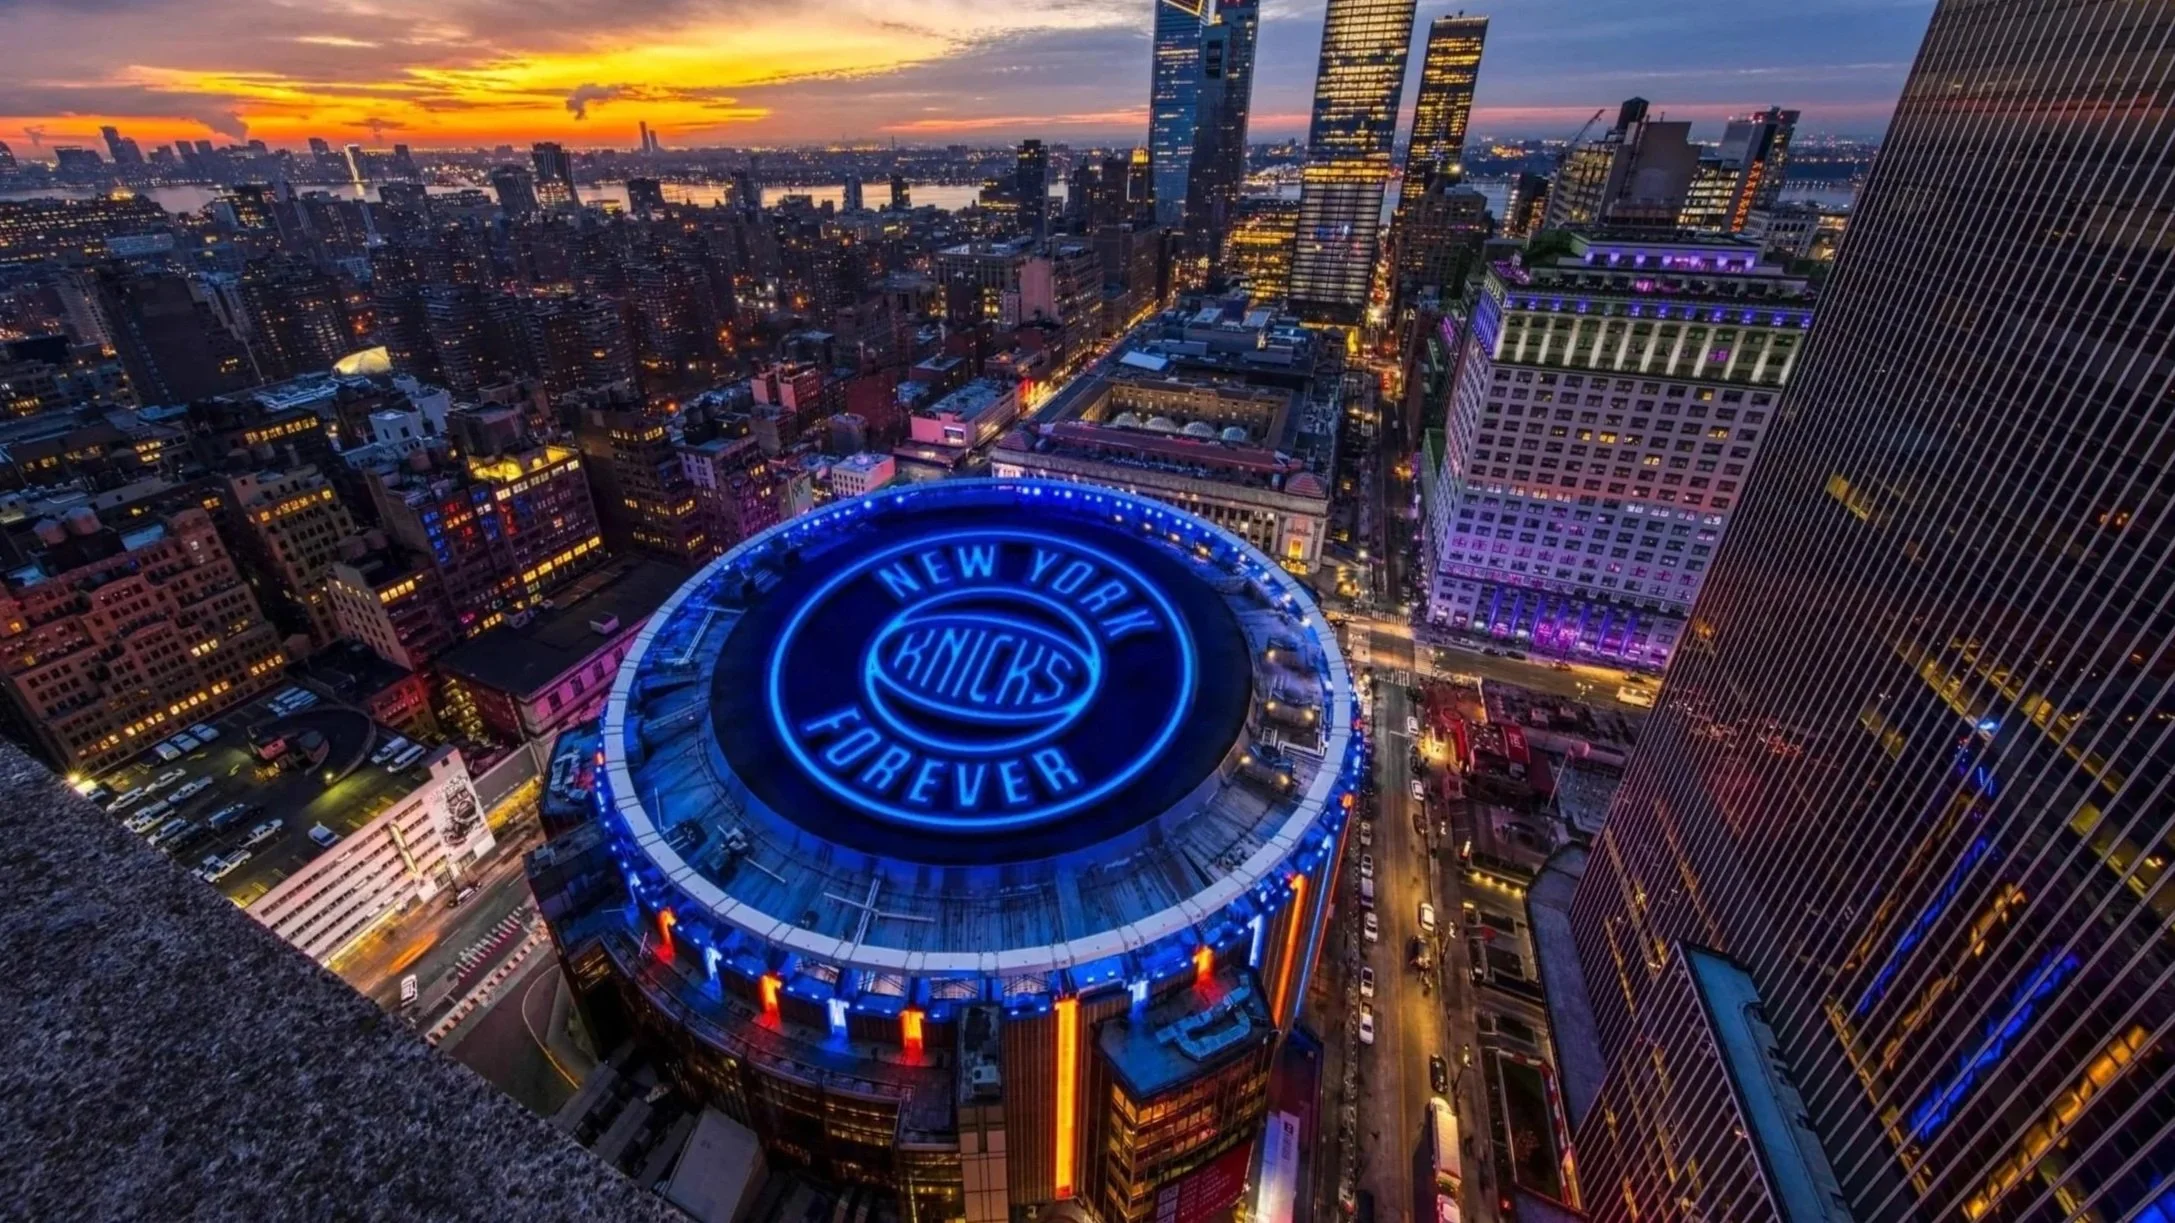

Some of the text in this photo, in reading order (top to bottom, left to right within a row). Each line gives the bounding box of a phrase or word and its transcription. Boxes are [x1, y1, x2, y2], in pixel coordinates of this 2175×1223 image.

[879, 544, 1156, 637] NEW YORK
[893, 627, 1074, 705] KNICKS
[804, 707, 1080, 806] FOREVER
